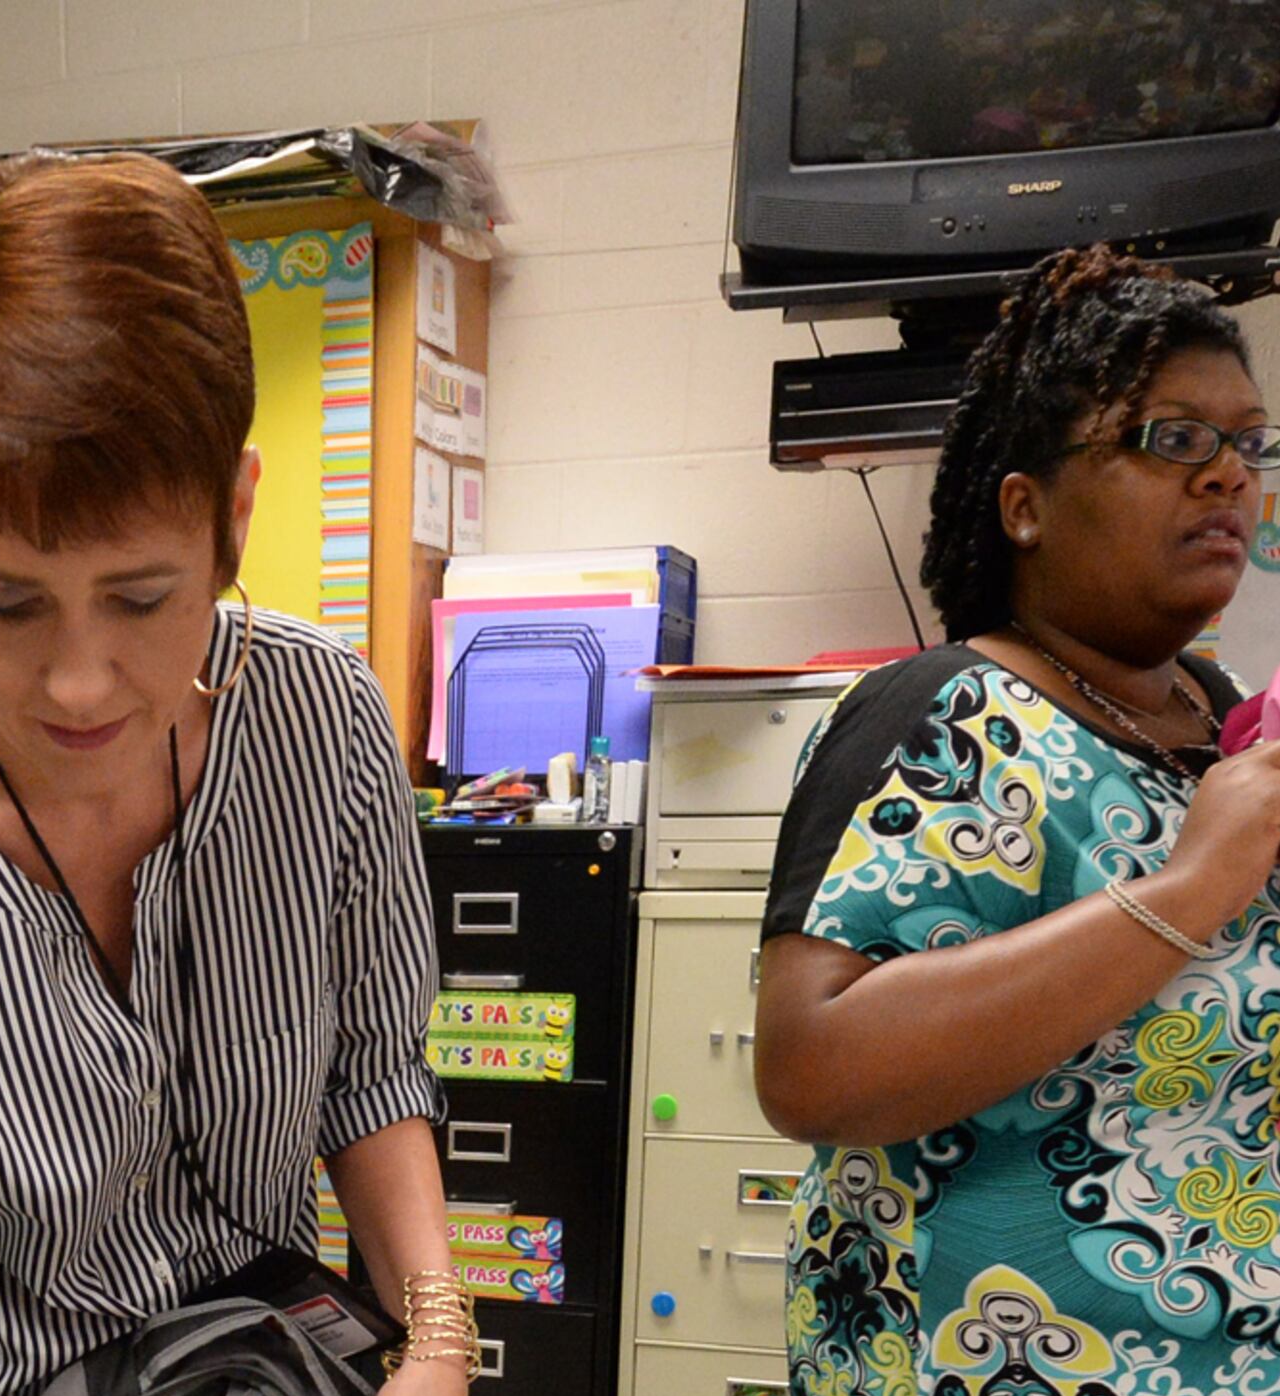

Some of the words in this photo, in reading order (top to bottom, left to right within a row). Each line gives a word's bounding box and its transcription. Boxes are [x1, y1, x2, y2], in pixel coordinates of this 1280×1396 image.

[1007, 179, 1063, 196] SHARP
[481, 1004, 535, 1025] PASS
[480, 1047, 533, 1067] PASS
[463, 1224, 505, 1242] PASS
[466, 1267, 508, 1285] PASS
